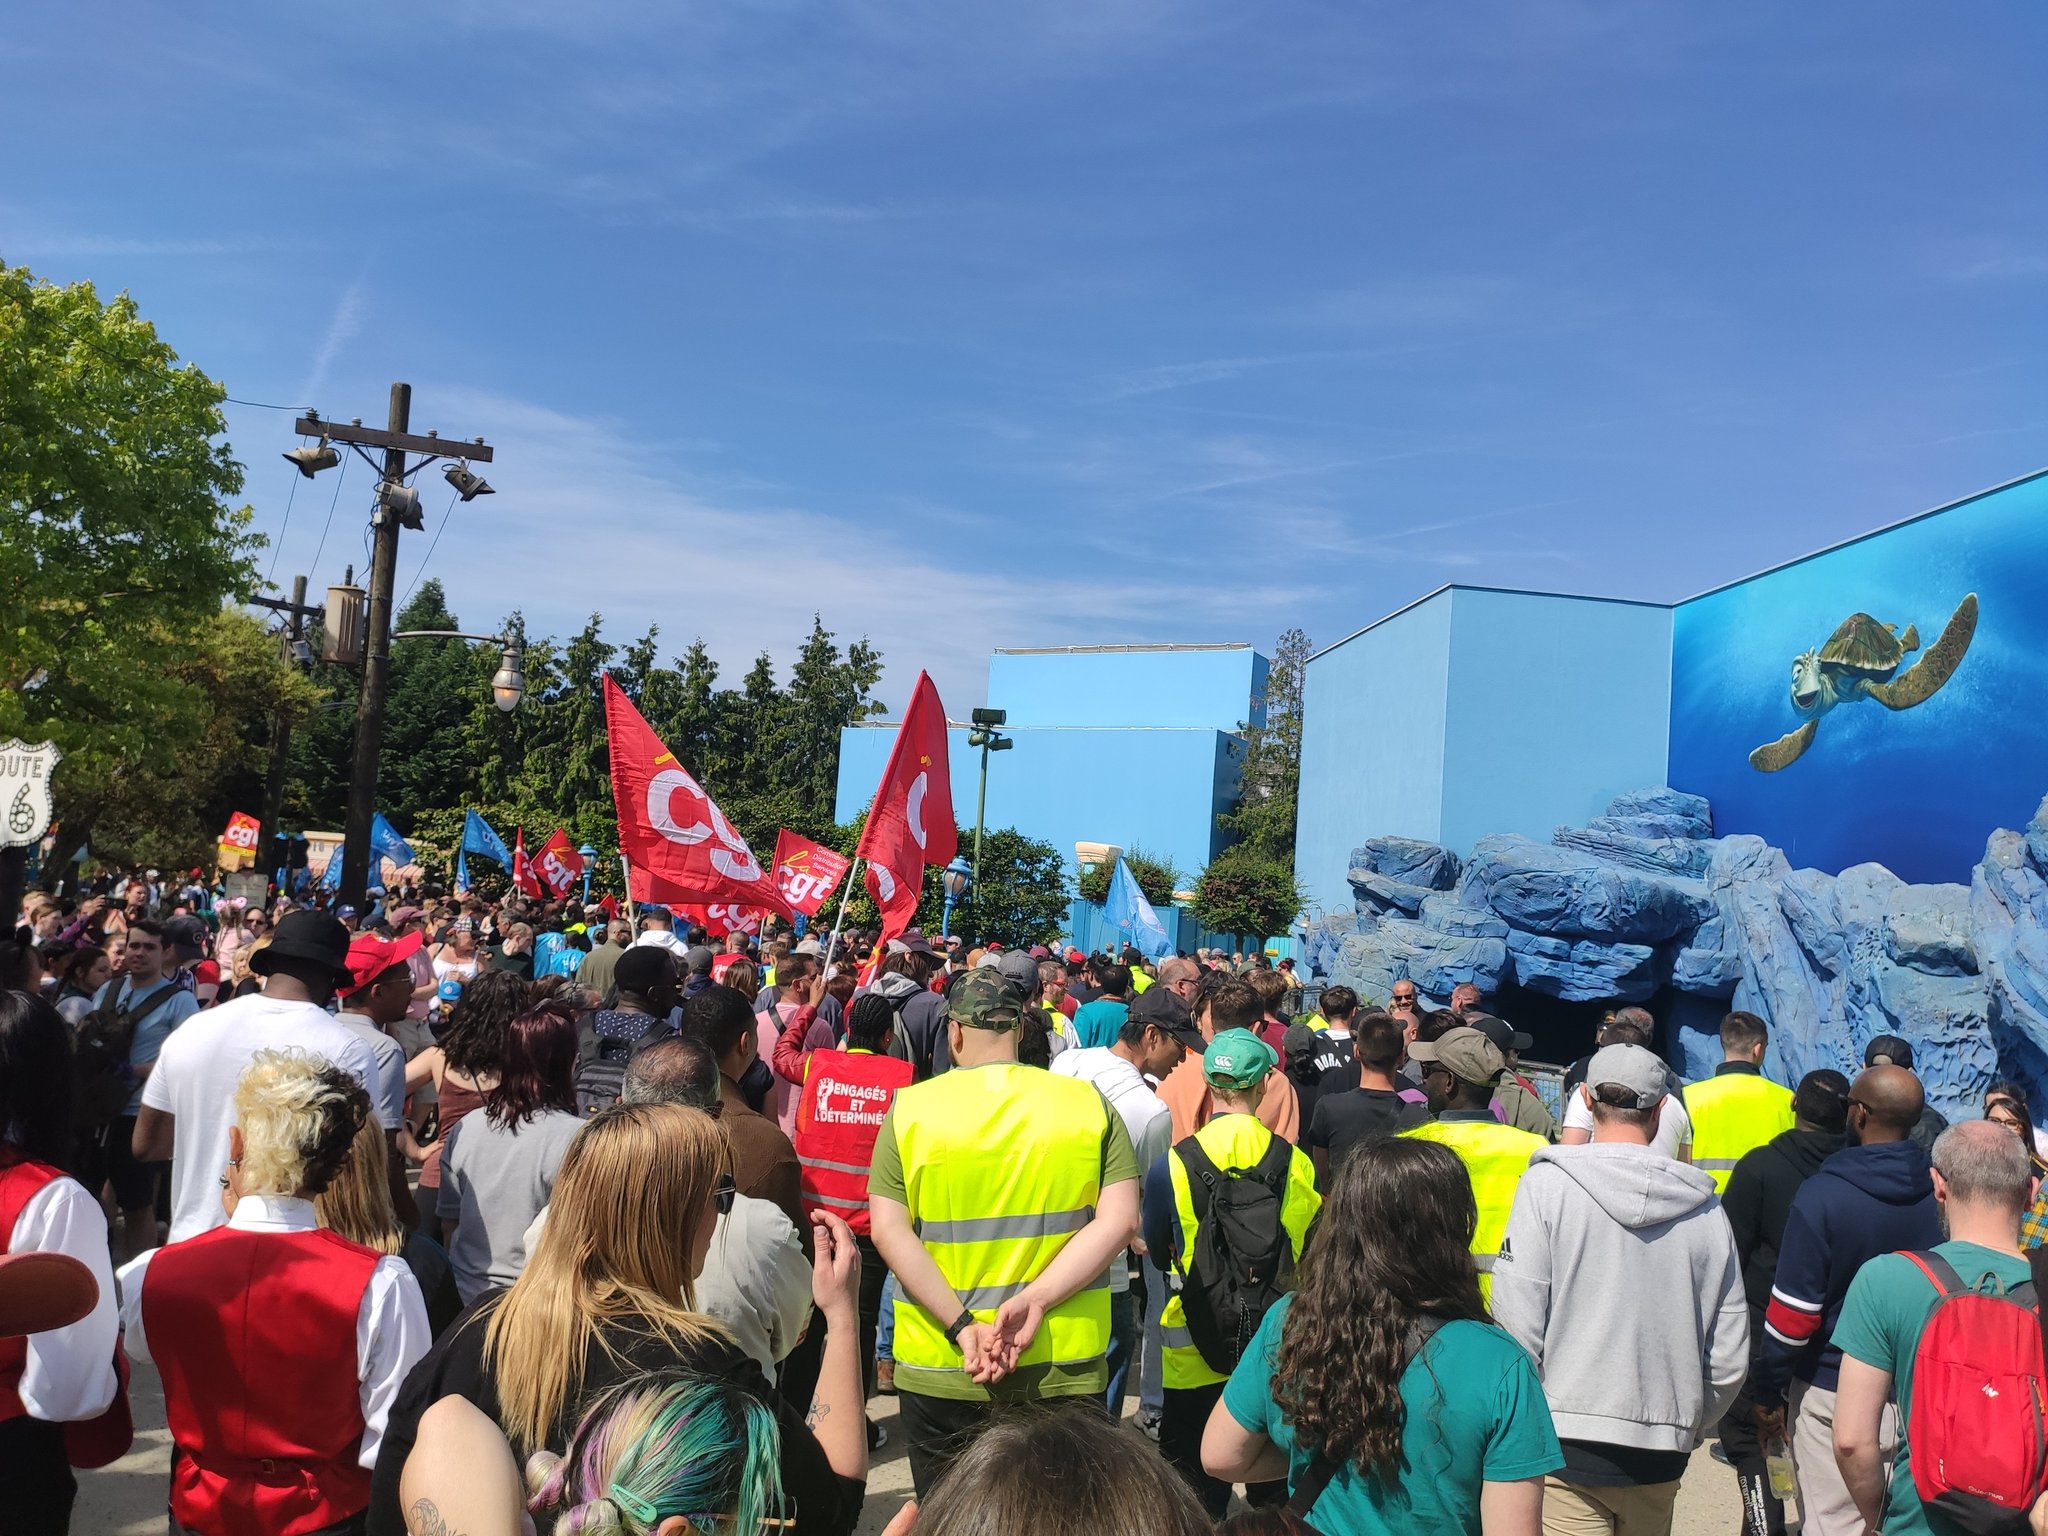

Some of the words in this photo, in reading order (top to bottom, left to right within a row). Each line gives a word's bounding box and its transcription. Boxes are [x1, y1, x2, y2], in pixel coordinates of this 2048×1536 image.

[0, 755, 43, 778] OUTE
[647, 769, 761, 882] cg
[777, 864, 835, 904] cgt
[1313, 1052, 1351, 1073] DURA
[834, 1083, 887, 1101] ENGAGÉS
[850, 1099, 865, 1112] ET
